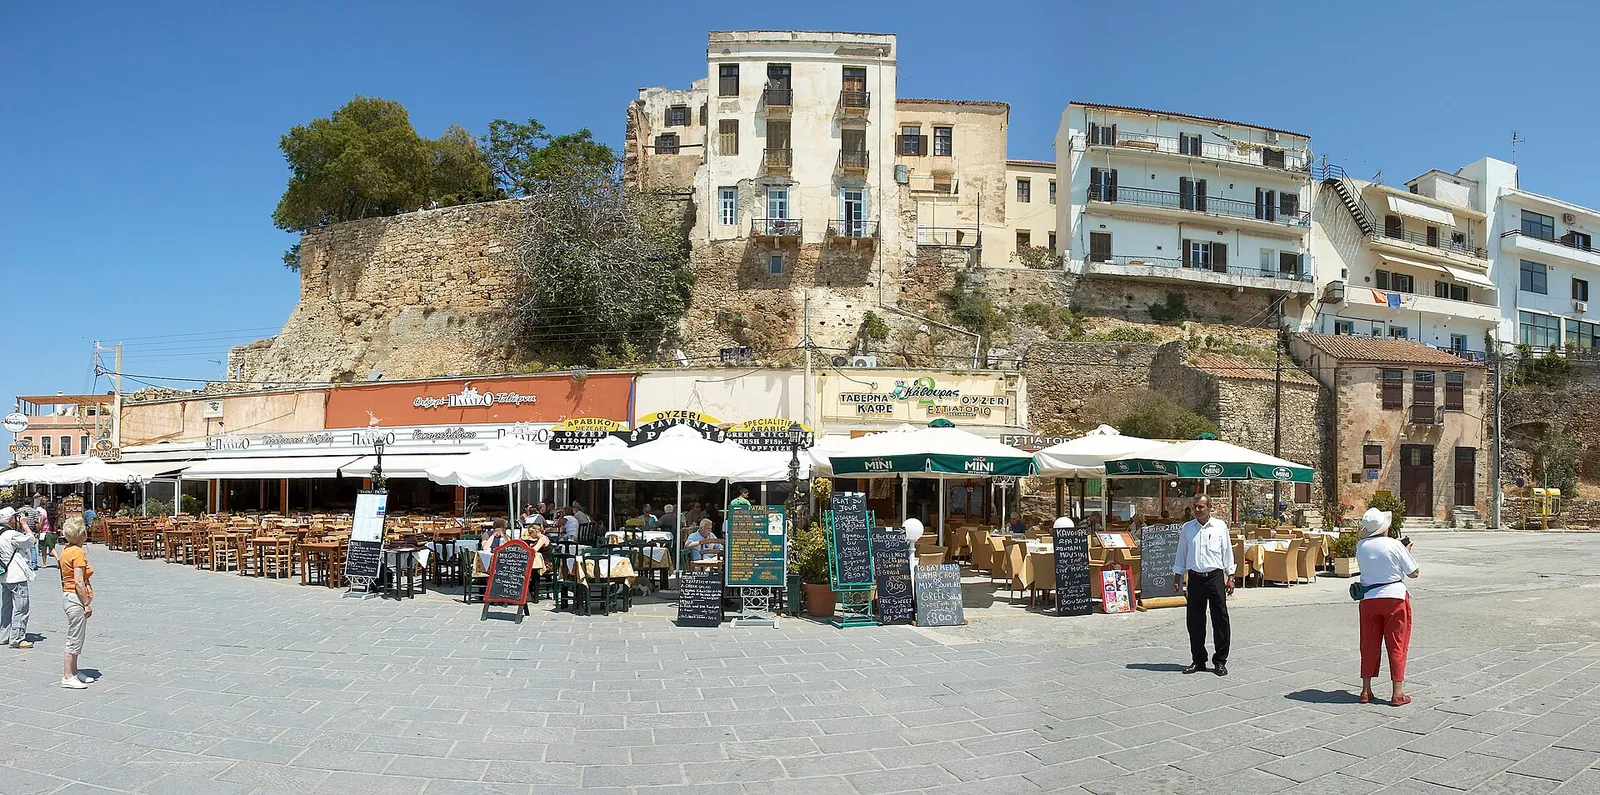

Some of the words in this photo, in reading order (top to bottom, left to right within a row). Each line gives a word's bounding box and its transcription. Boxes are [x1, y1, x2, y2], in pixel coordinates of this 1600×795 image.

[919, 377, 935, 404] 2
[841, 394, 889, 402] ΤΑΒΕΡΝΑ
[961, 396, 1010, 406] OYZERI
[857, 404, 893, 413] ΚΑΦΕ
[927, 405, 992, 416] ΕΣΤΙΑΤΟΡΙΟ
[656, 410, 702, 420] OYZERI
[648, 418, 709, 431] TAVERNA
[743, 418, 793, 429] SPECIALITIE
[864, 460, 893, 470] MINI
[964, 460, 995, 472] MINI
[832, 497, 849, 505] PLAT
